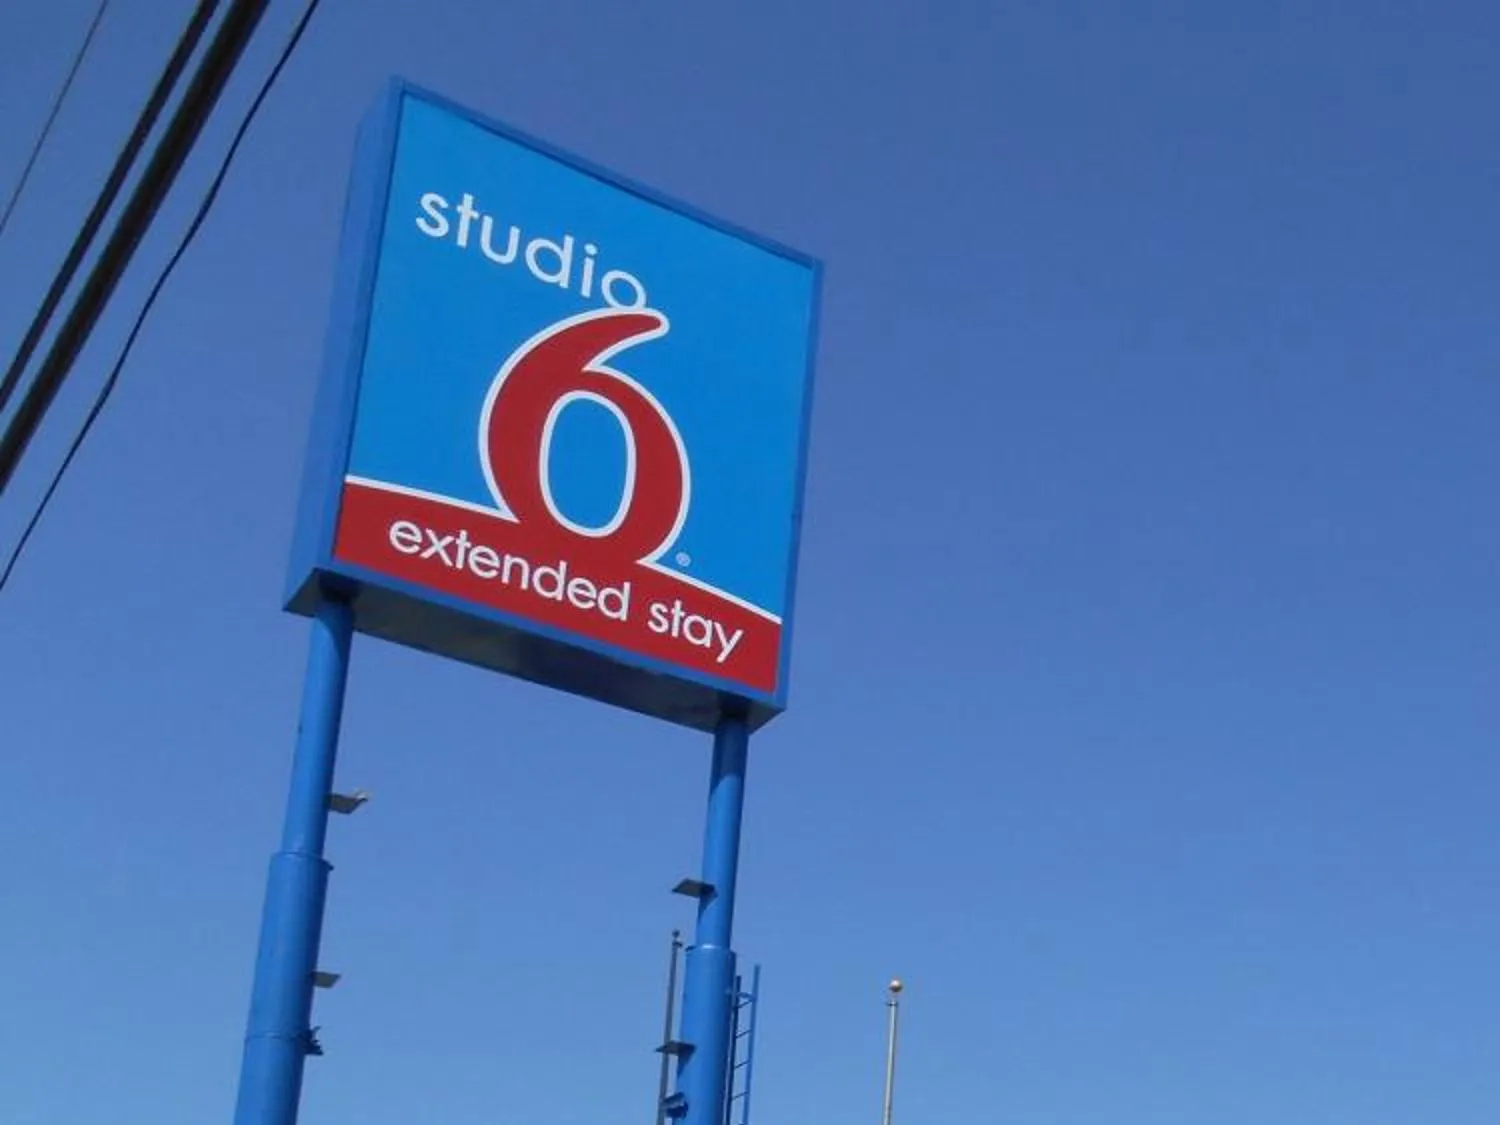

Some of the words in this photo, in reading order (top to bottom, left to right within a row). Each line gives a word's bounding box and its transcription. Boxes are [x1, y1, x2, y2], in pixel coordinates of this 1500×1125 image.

[415, 192, 647, 309] studio
[478, 307, 691, 567] 6
[388, 519, 631, 621] extended
[647, 600, 744, 663] stay
